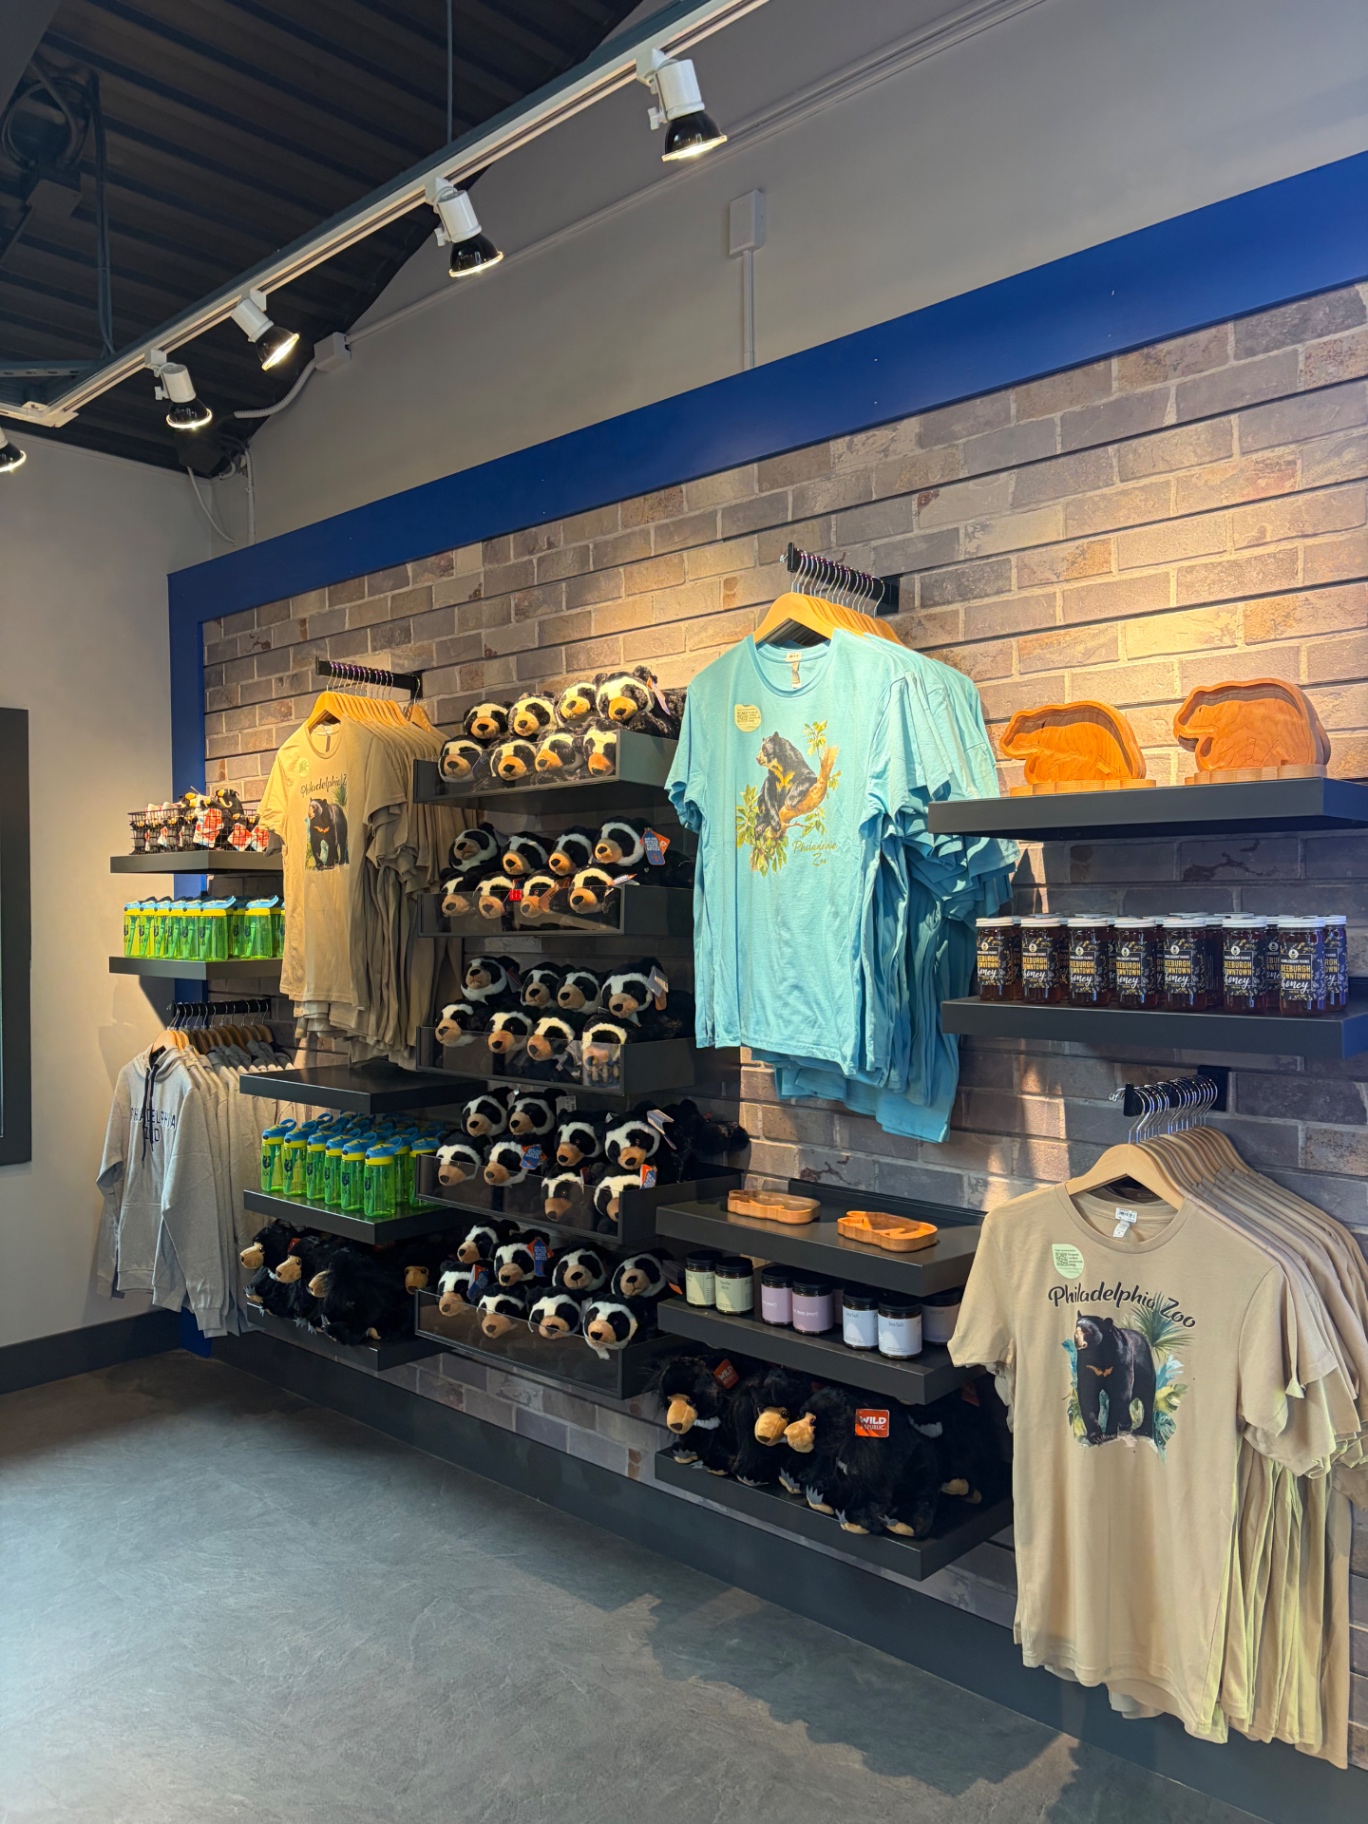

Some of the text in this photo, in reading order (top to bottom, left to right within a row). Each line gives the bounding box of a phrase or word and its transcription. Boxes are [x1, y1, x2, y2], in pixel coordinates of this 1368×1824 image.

[1116, 968, 1141, 976] WNTOWN
[1165, 966, 1191, 974] WNTOWN
[1225, 973, 1250, 990] honey
[1281, 977, 1310, 994] honey
[1048, 1281, 1196, 1328] Philadelphia Zoo
[859, 1416, 887, 1425] WILD
